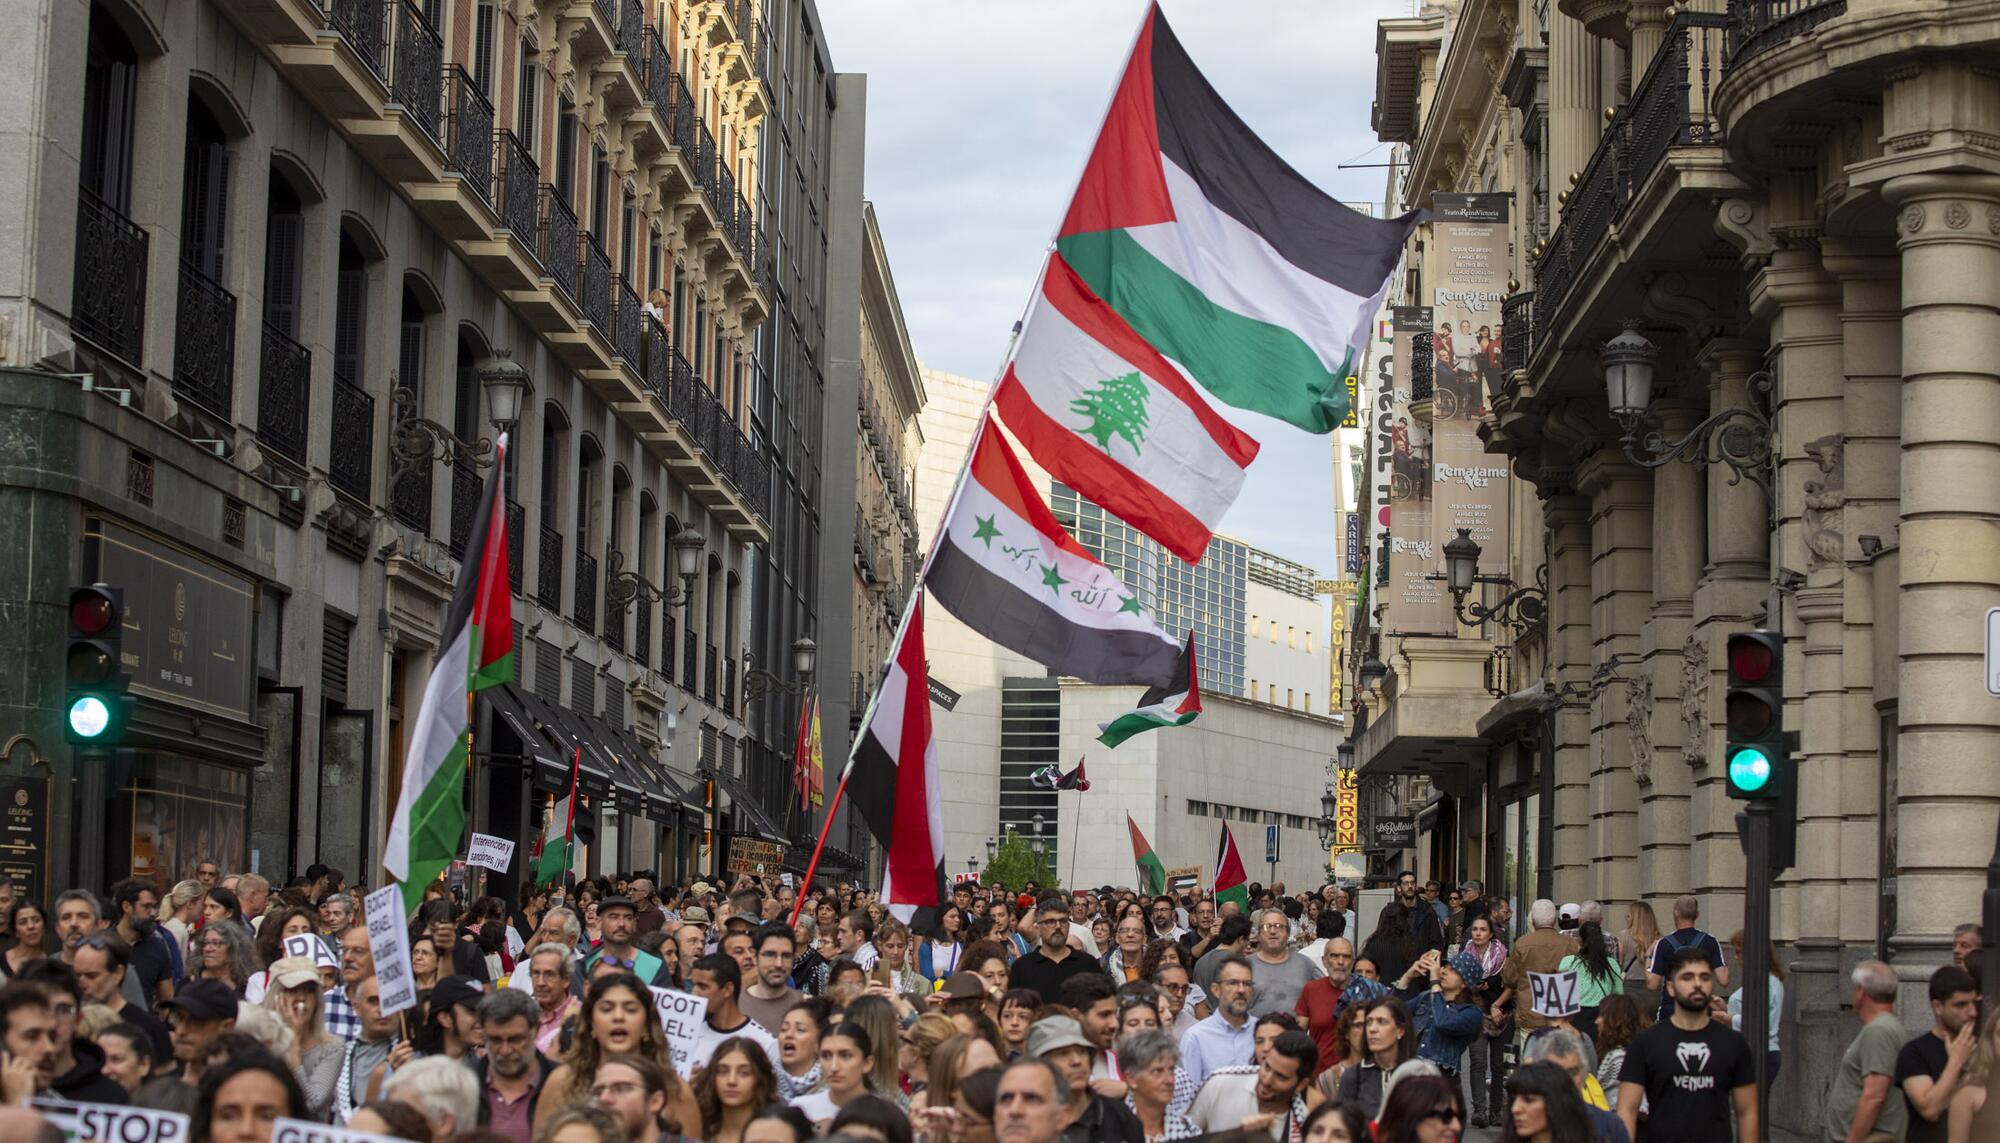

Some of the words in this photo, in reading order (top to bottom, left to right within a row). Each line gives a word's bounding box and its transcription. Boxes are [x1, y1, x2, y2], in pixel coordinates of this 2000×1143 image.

[1434, 287, 1499, 306] Rematam
[1348, 515, 1357, 570] CARRERA
[1316, 581, 1356, 589] HOSTAL
[1331, 604, 1344, 704] AGUILAR
[655, 993, 700, 1016] ICOT
[1532, 975, 1579, 1014] PAZ
[1673, 1076, 1714, 1091] VENUM
[81, 1110, 178, 1143] STOP
